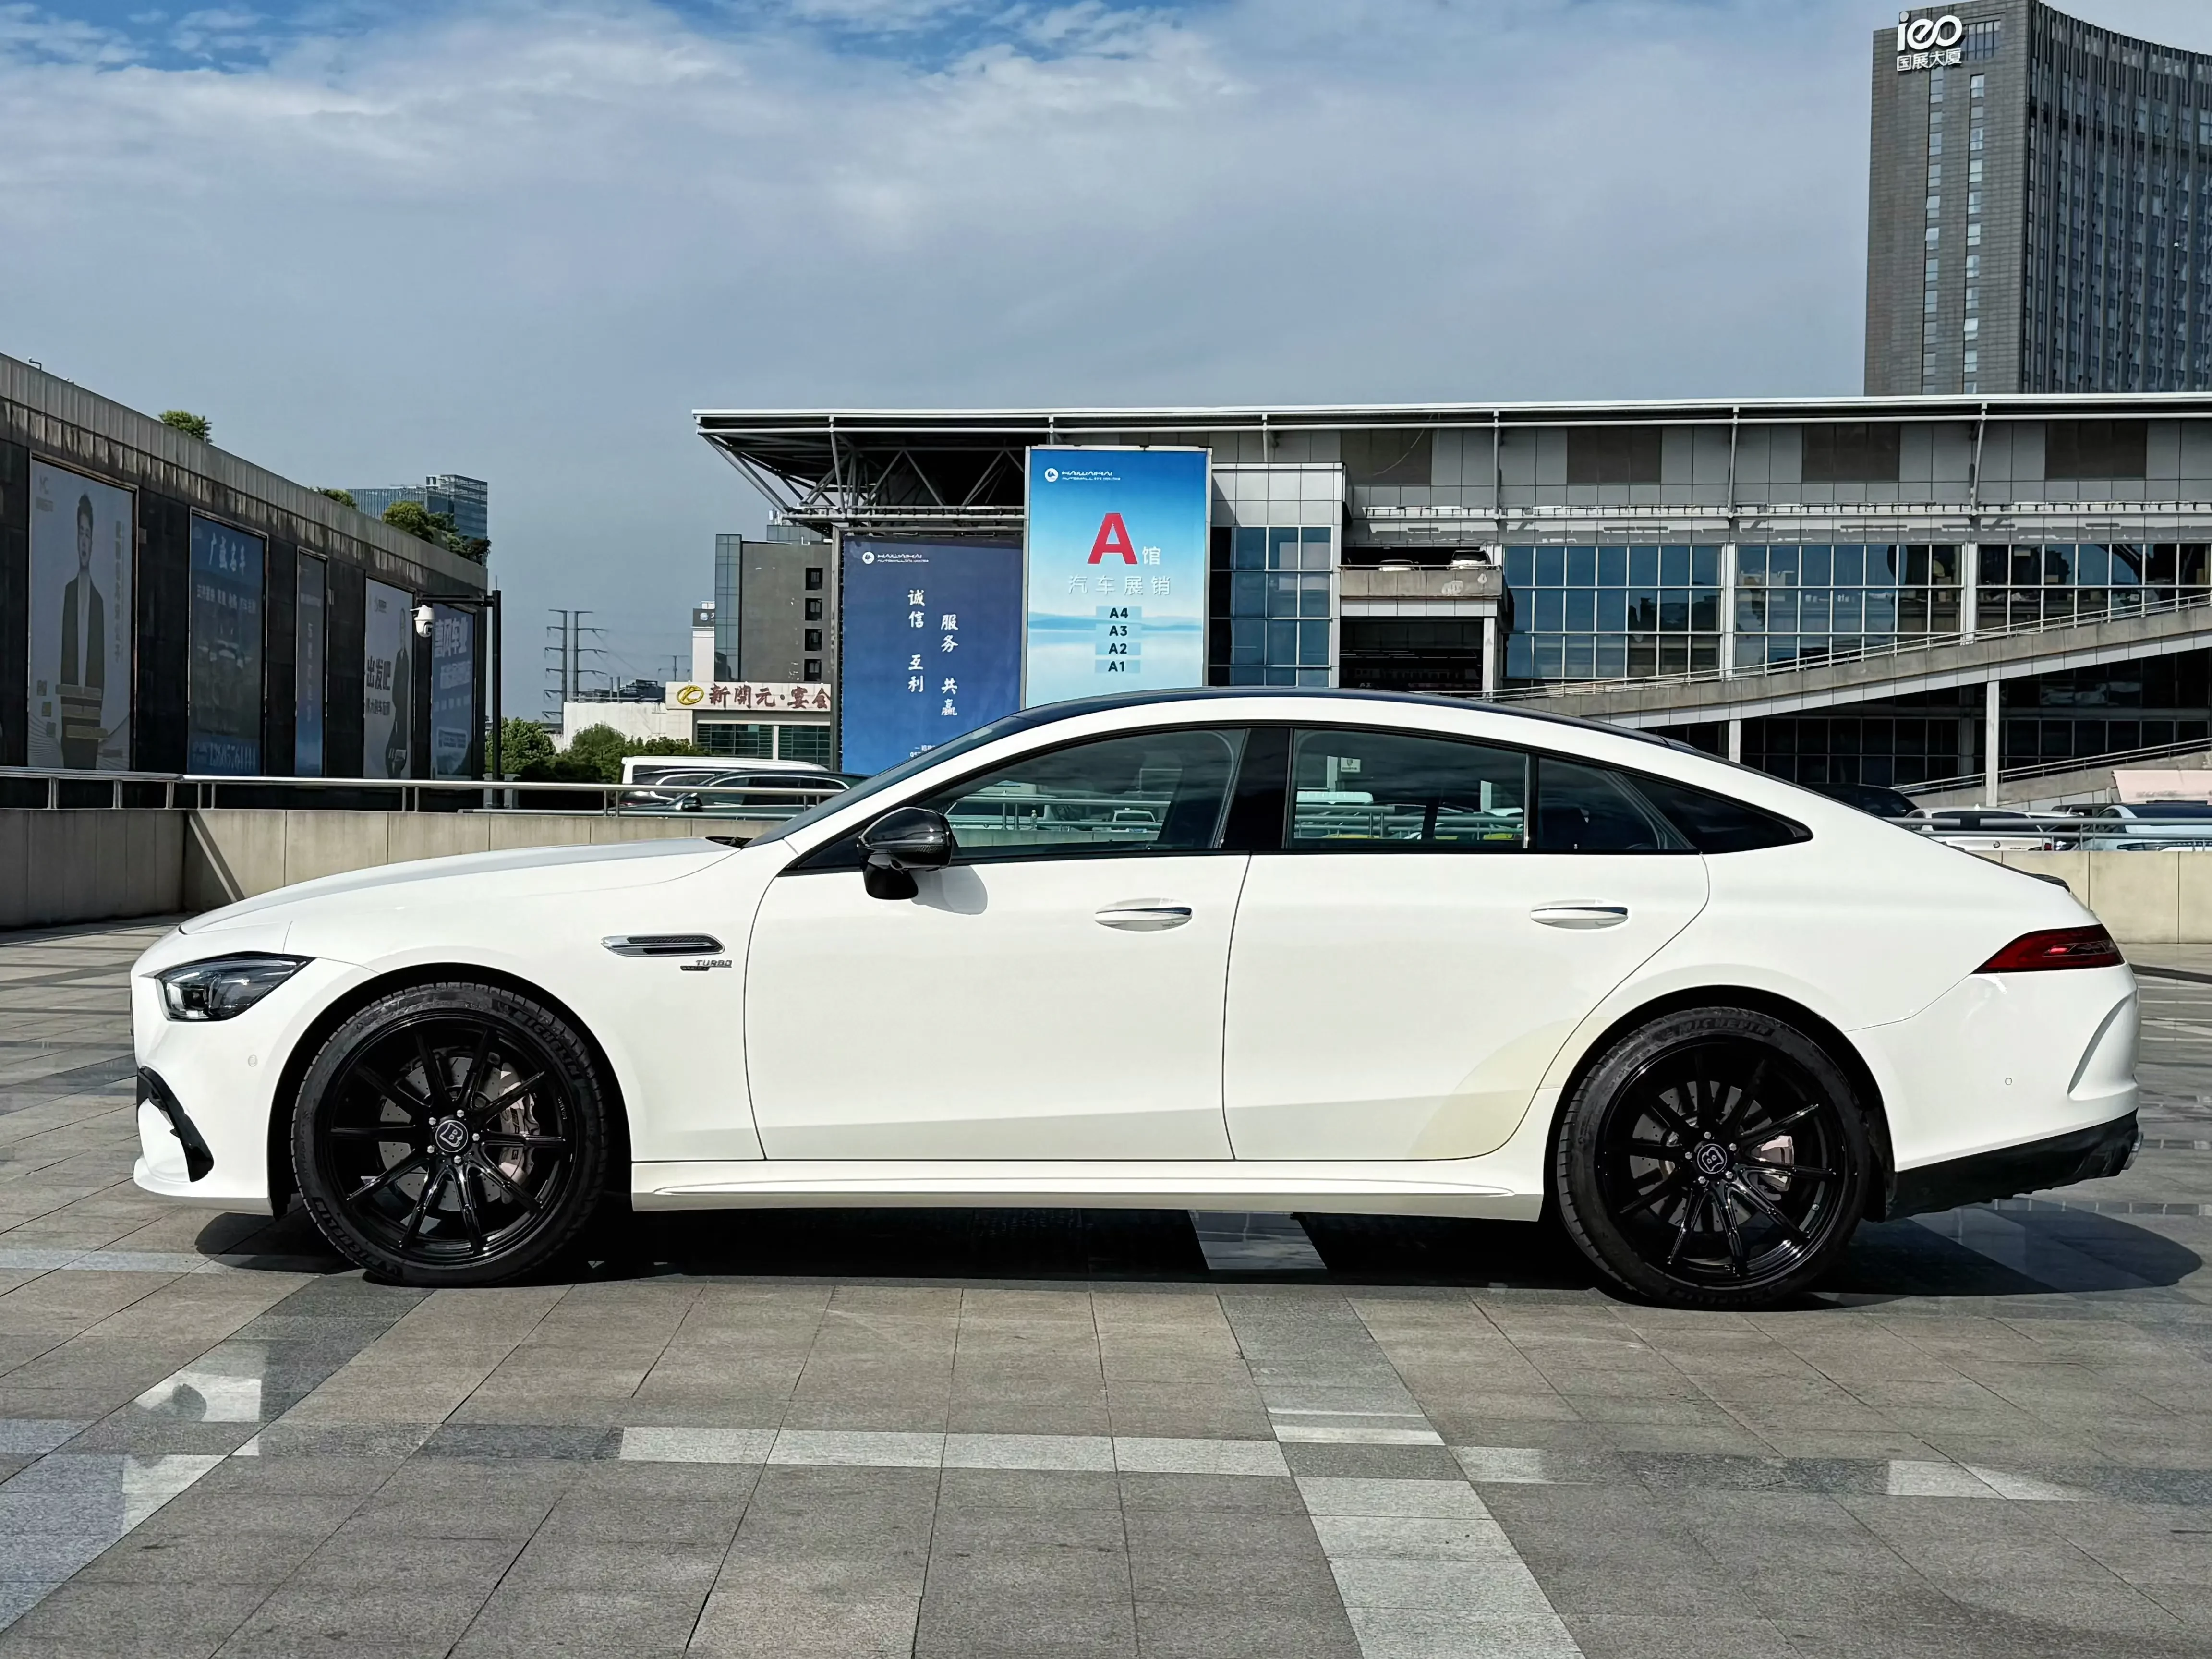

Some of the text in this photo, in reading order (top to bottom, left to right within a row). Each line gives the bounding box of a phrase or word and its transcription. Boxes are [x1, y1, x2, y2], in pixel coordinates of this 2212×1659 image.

[1897, 48, 1962, 71] 国展大厦
[1068, 574, 1171, 596] 汽车展销
[1110, 607, 1128, 618] A4
[1109, 625, 1128, 636] A3
[907, 589, 925, 692] 诚信 互利
[1109, 643, 1127, 654] A2
[941, 614, 959, 716] 服务 共赢
[1108, 661, 1124, 672] A1
[1679, 1017, 1770, 1036] MICHELIN
